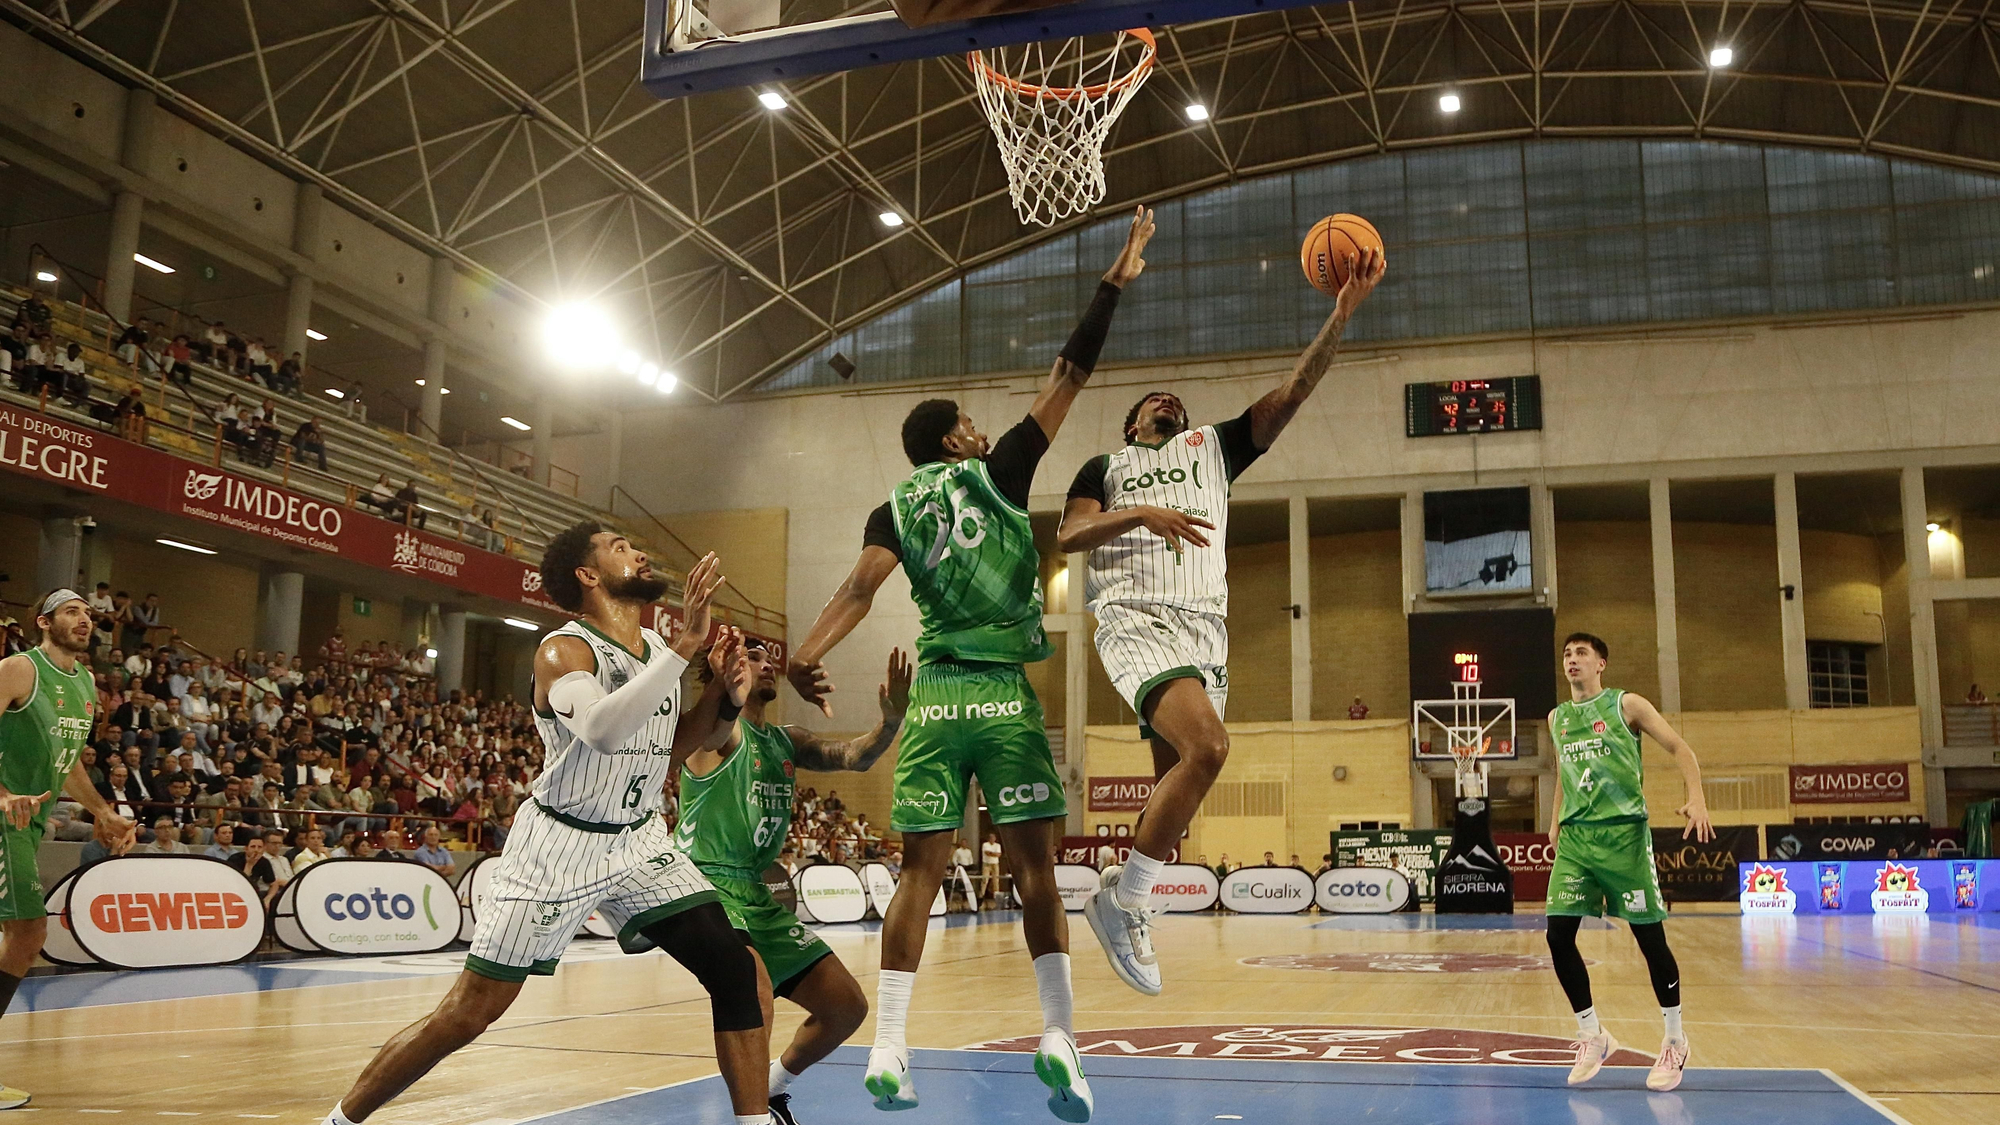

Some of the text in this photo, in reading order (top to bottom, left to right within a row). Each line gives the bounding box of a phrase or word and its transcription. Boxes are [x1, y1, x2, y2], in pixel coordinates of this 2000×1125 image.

[1444, 403, 1458, 415] 42
[1492, 400, 1506, 412] 35
[0, 410, 94, 449] AL DEPORTES
[0, 430, 109, 489] LEGRE
[1122, 467, 1186, 492] coto
[224, 477, 342, 536] IMDECO
[183, 503, 339, 553] Instituto Municipal de Deportes Córdoba
[914, 485, 987, 570] 76
[1462, 665, 1478, 681] 10
[58, 716, 91, 730] AMICS
[49, 726, 89, 740] CASTELL
[1563, 738, 1603, 754] AMICS
[55, 748, 77, 773] 42
[1576, 767, 1594, 792] 4
[1820, 772, 1904, 790] IMDECO
[621, 774, 648, 810] 15
[752, 781, 792, 796] AMICS
[1114, 784, 1155, 799] IMD
[746, 792, 793, 809] CASTELL
[754, 817, 783, 847] 67
[1497, 843, 1556, 864] DECO
[1821, 838, 1876, 852] COVAP
[1655, 846, 1737, 872] RNICAZA
[1444, 874, 1485, 884] SIERRA
[823, 888, 860, 896] SEBASTIAN
[1152, 884, 1208, 895] RDOBA
[1250, 882, 1301, 899] Cualix
[1328, 880, 1381, 897] coto
[1443, 882, 1505, 894] MORENA
[324, 887, 415, 921] coto
[1748, 900, 1788, 908] TOSFRIT
[1879, 899, 1920, 907] TOSFRIT
[329, 933, 371, 945] Contigo,
[1075, 1039, 1578, 1064] MDECO
